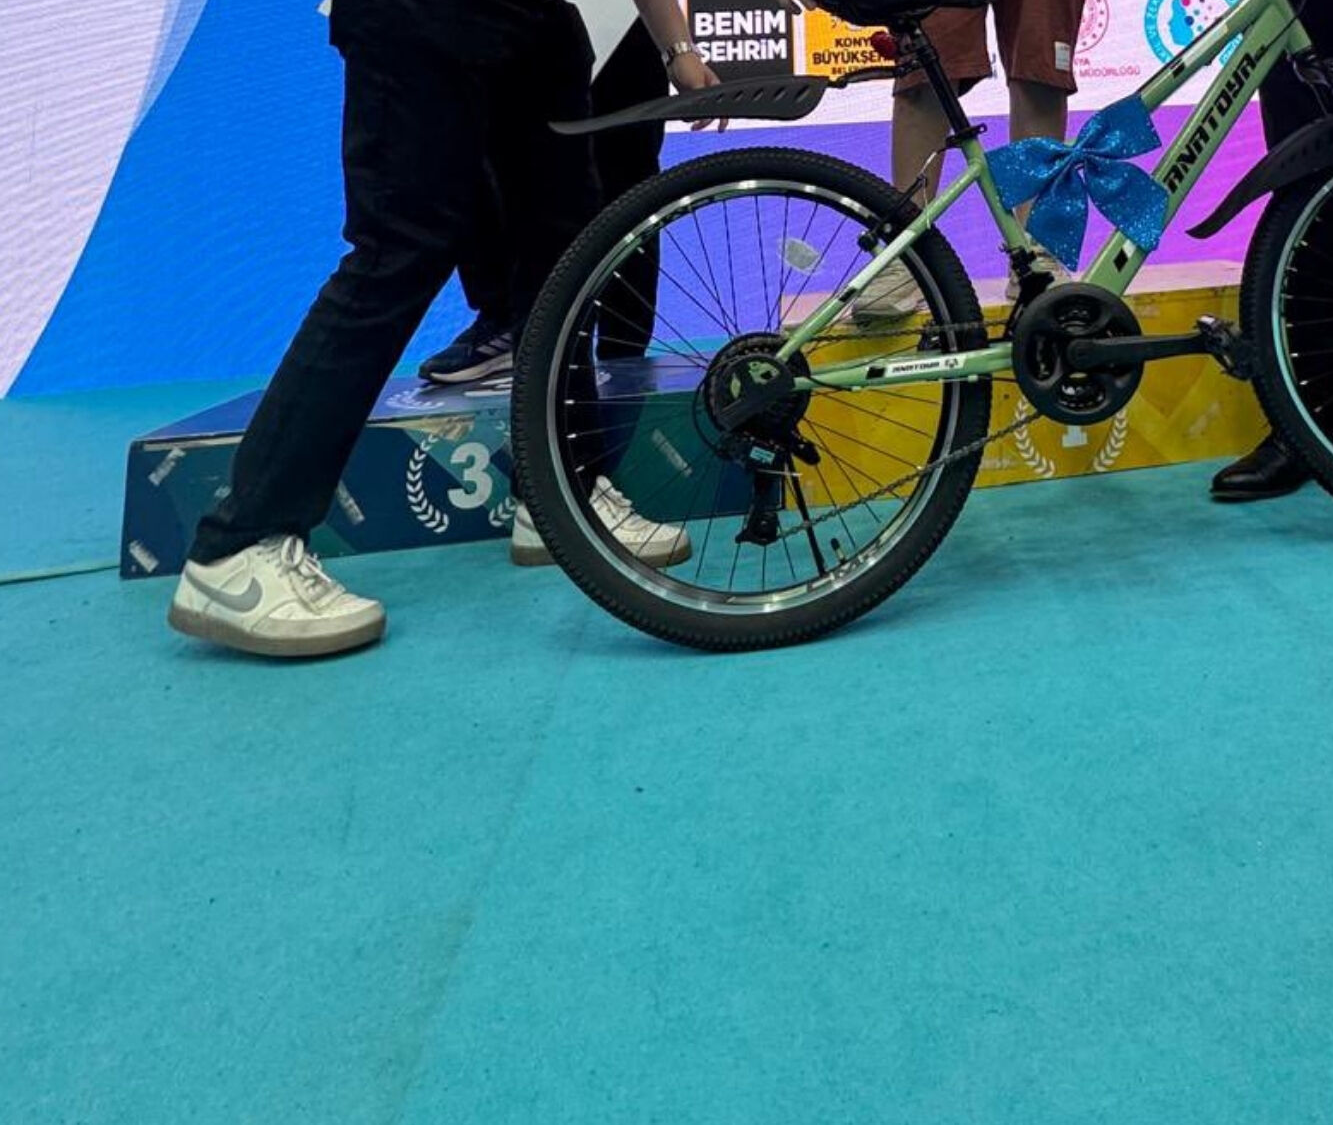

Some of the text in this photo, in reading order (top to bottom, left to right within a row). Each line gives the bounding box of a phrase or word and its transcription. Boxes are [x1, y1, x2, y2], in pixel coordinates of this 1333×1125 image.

[694, 9, 787, 37] BENİM
[834, 37, 876, 49] KONY
[448, 442, 493, 509] 3
